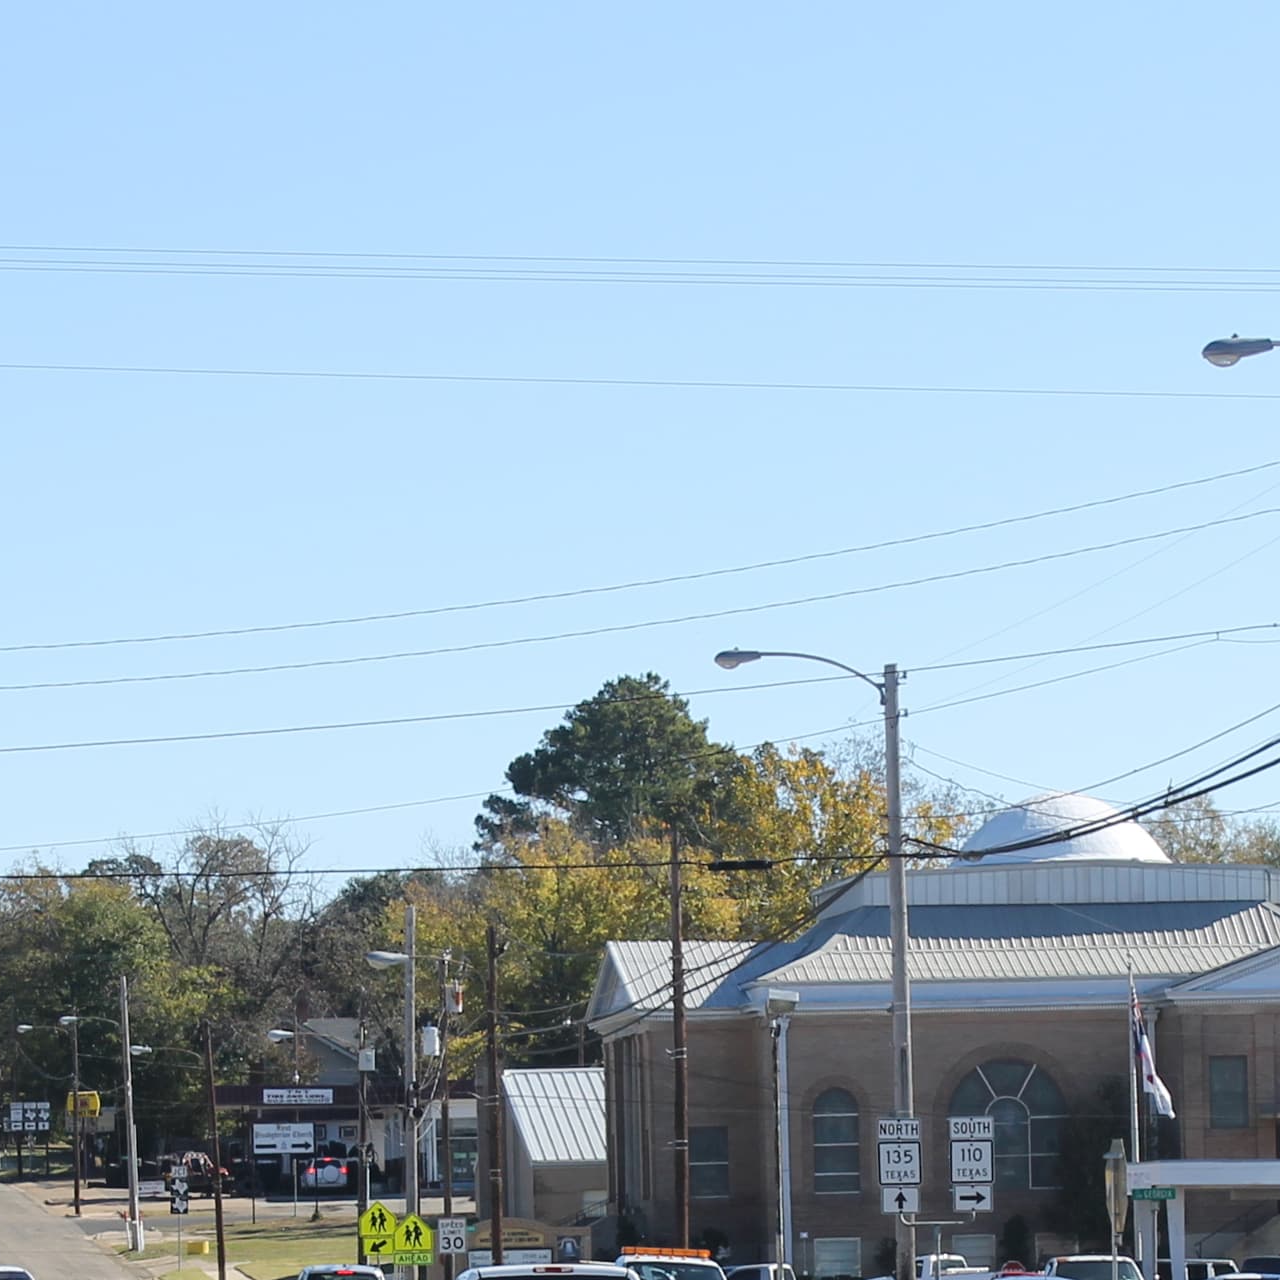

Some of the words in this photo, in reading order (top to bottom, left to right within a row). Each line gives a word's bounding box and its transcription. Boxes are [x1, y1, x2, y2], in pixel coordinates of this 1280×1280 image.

[880, 1123, 918, 1135] NORTH
[953, 1122, 990, 1134] SOUTH
[887, 1150, 913, 1164] 135
[961, 1148, 982, 1161] 110
[885, 1170, 916, 1179] TEXAS
[958, 1168, 987, 1177] TEXAS
[441, 1236, 464, 1250] 30
[398, 1255, 429, 1263] AHEAD
